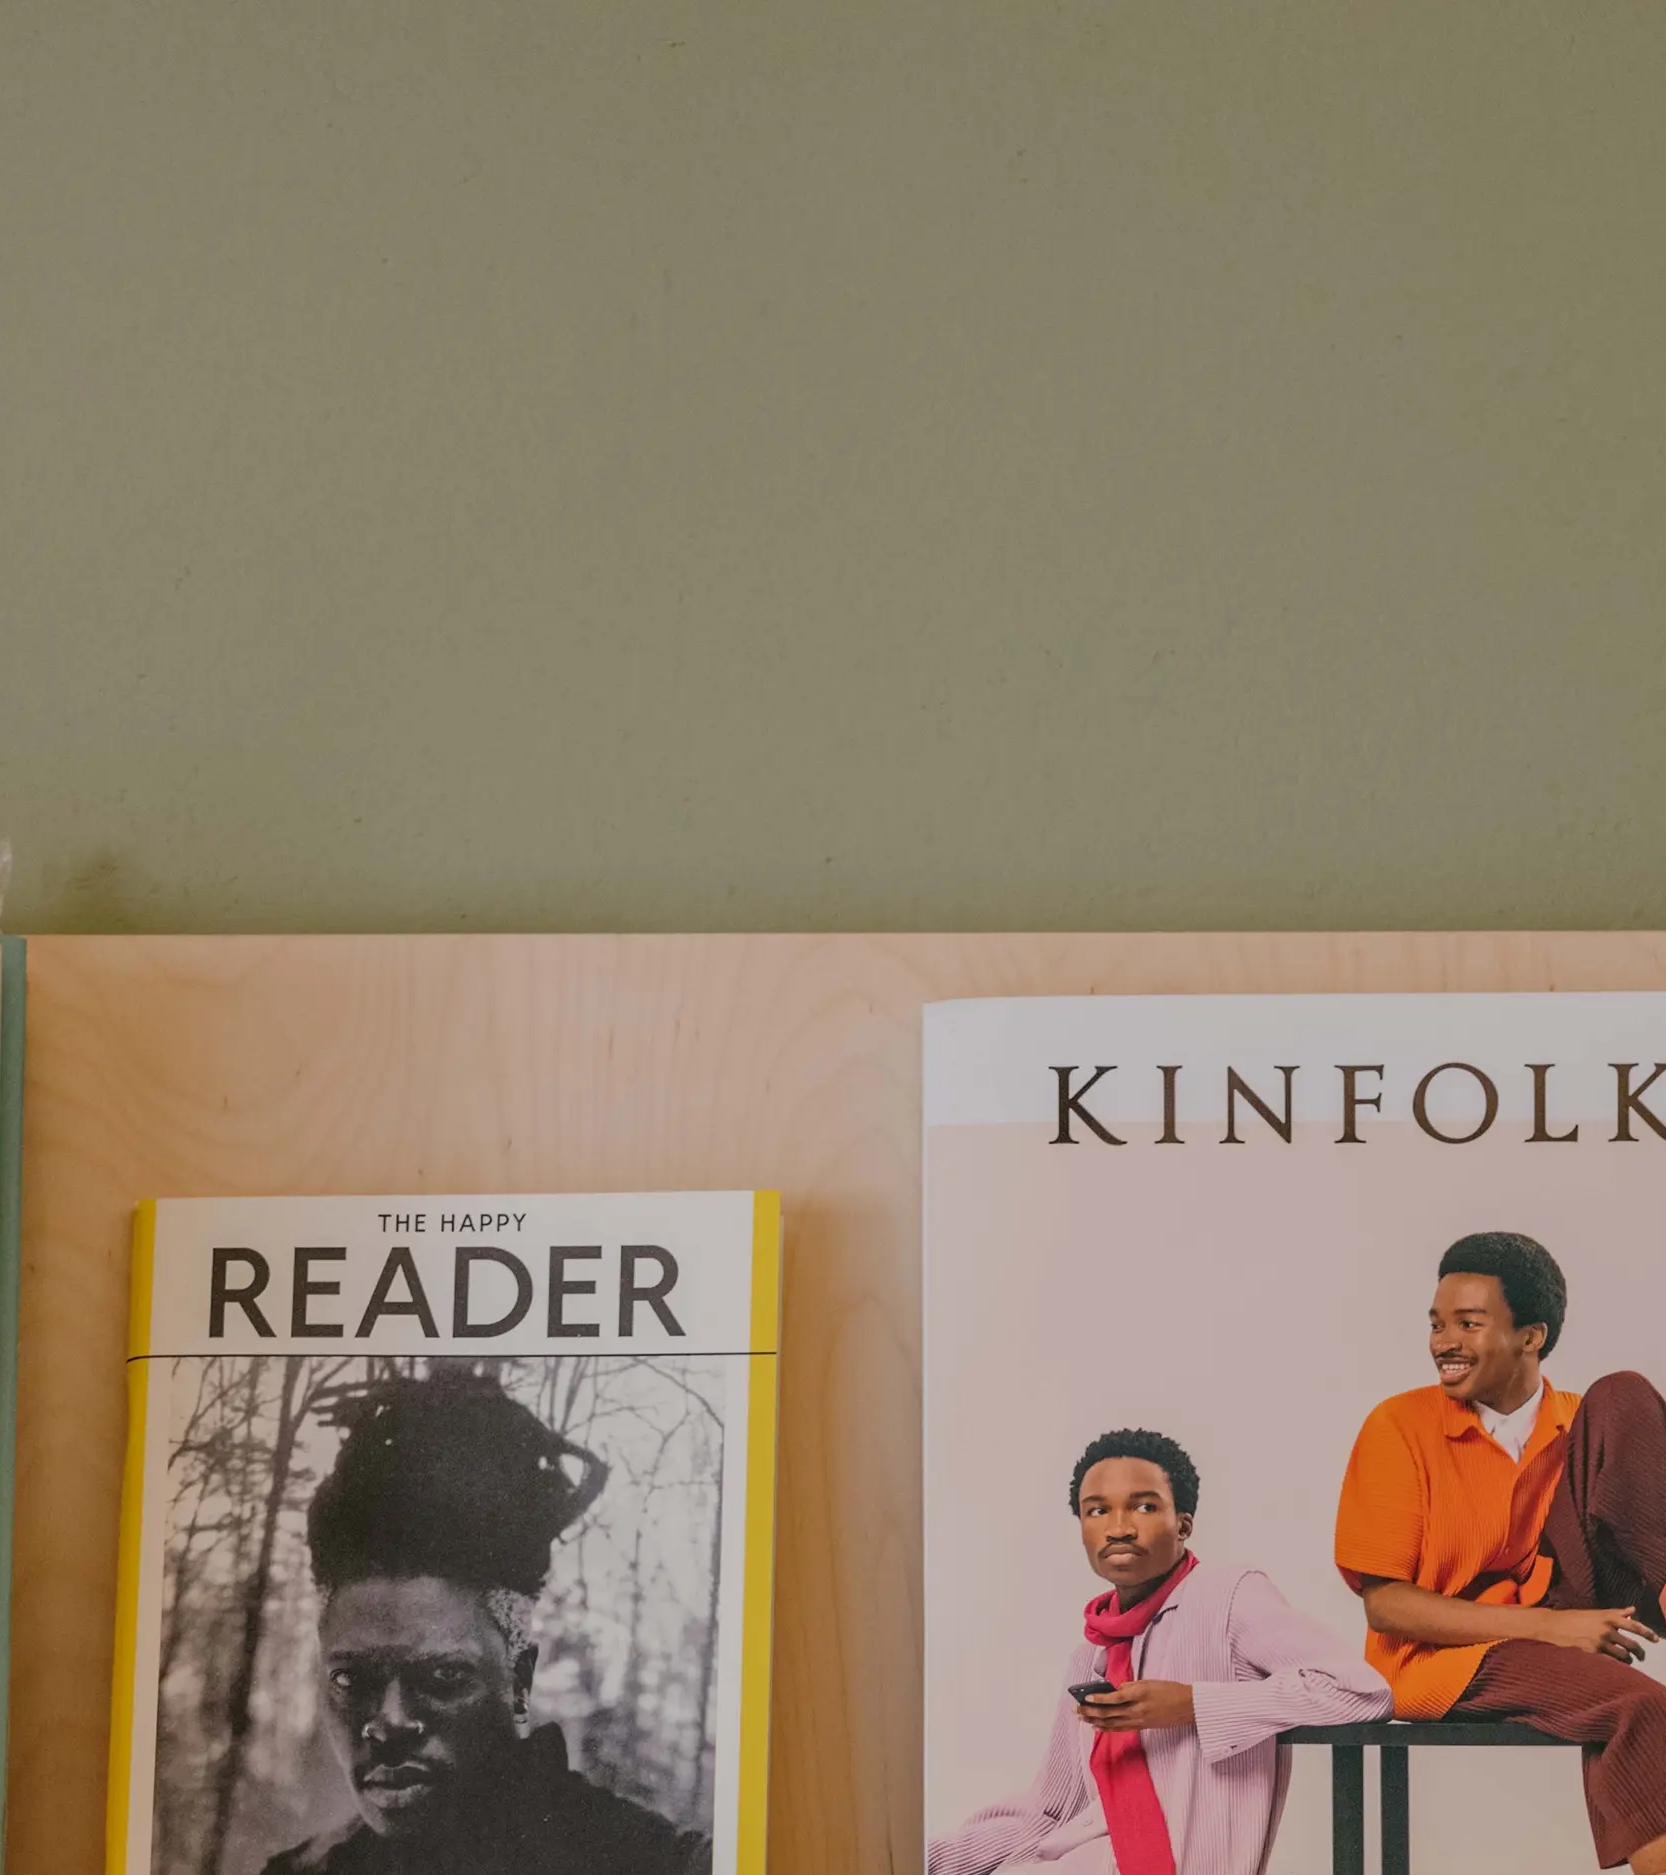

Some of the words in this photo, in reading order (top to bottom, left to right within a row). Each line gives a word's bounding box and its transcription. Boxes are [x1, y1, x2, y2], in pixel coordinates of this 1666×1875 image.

[377, 1214, 426, 1232] THE
[441, 1213, 526, 1232] HAPPY
[208, 1244, 686, 1339] READER
